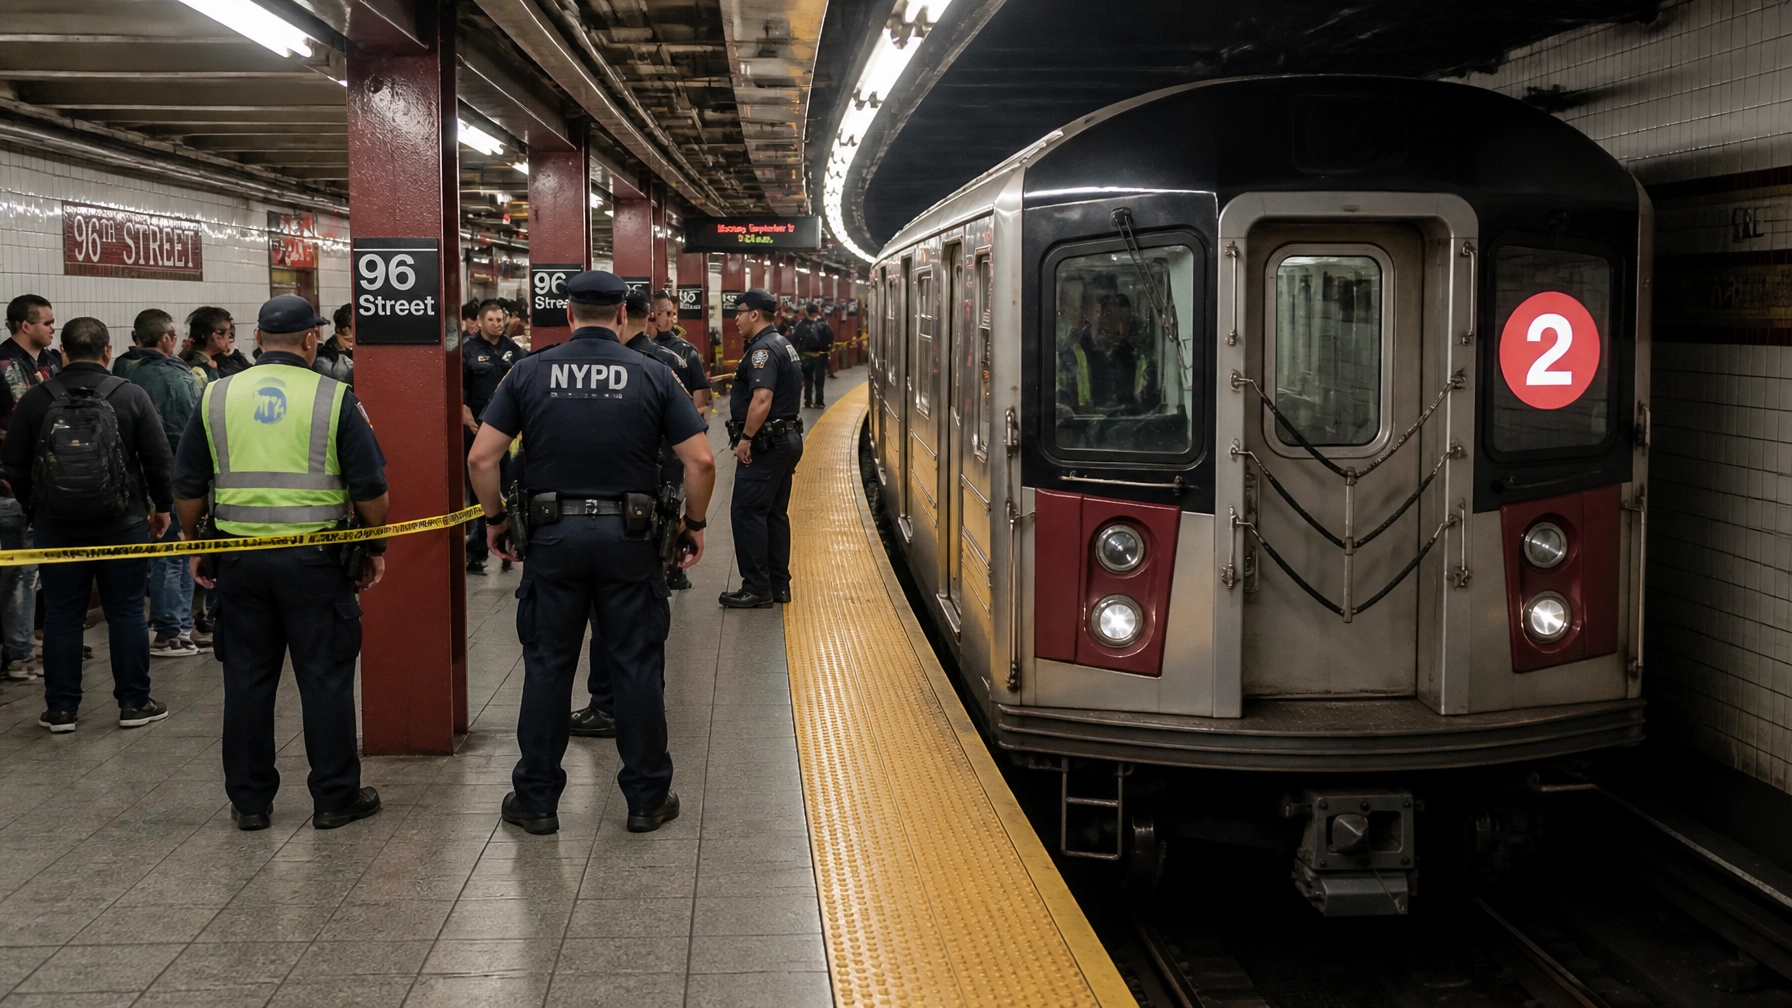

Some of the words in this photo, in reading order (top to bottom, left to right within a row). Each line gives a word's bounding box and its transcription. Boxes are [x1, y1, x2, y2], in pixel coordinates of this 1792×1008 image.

[123, 222, 195, 268] STREET
[358, 253, 416, 291] 96
[533, 272, 567, 295] 96
[358, 294, 435, 316] Street
[1525, 313, 1573, 386] 2
[550, 363, 628, 390] NYPD
